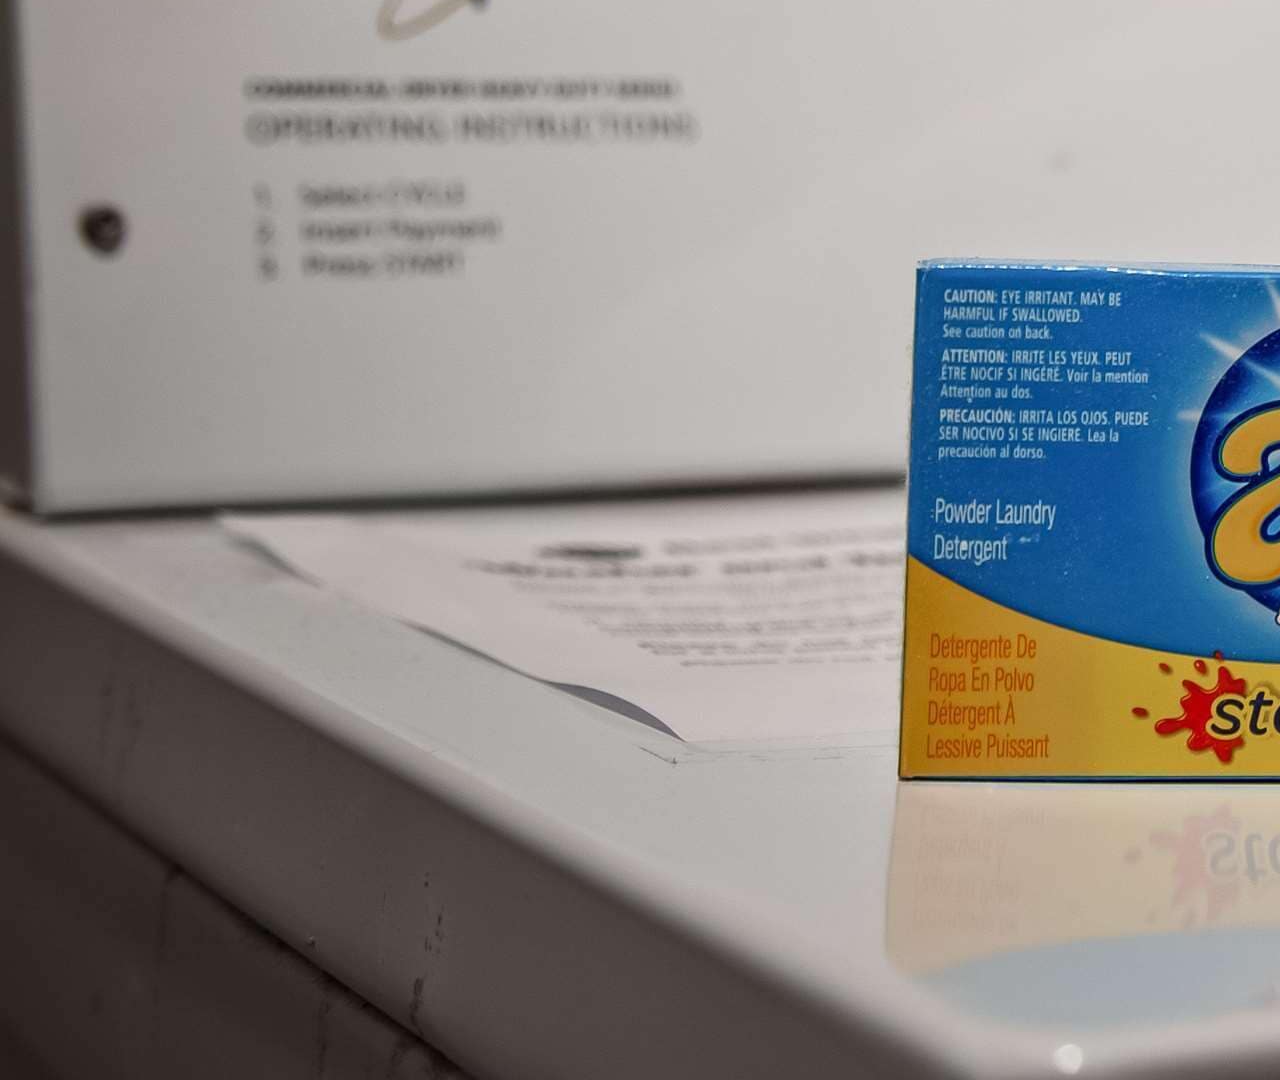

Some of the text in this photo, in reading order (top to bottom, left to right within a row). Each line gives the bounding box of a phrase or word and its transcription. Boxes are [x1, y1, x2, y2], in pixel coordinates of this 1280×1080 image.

[944, 289, 1122, 307] CAUTION: EYE IRRITANT. MAY BE
[943, 306, 1083, 323] HARMFUL IF SWALLOWED.
[943, 324, 1053, 340] See caution on back.
[941, 348, 1132, 366] ATTENTION: IRRITE LES YEUX. PEUT
[970, 366, 1004, 381] NOCIF
[1007, 367, 1017, 382] SI
[1066, 368, 1088, 383] Voir
[1091, 368, 1102, 383] la
[1104, 369, 1149, 384] mention
[940, 383, 1033, 400] Attention au dos.
[939, 406, 1149, 426] PRECAUCIÓN: IRRITA LOS OJOS. PUEDE
[938, 426, 1119, 443] SER NOCIVO SI SE INGIERE. Lea la
[937, 443, 1046, 460] precaución al dorso.
[935, 497, 1057, 530] Powder Laundry
[933, 534, 1008, 566] Detergent
[929, 633, 1012, 664] Detergente
[1016, 633, 1037, 659] De
[928, 667, 1035, 696] Ropa En Polvo
[927, 700, 1001, 731] Détergent
[926, 733, 1050, 760] Lessive Puissant
